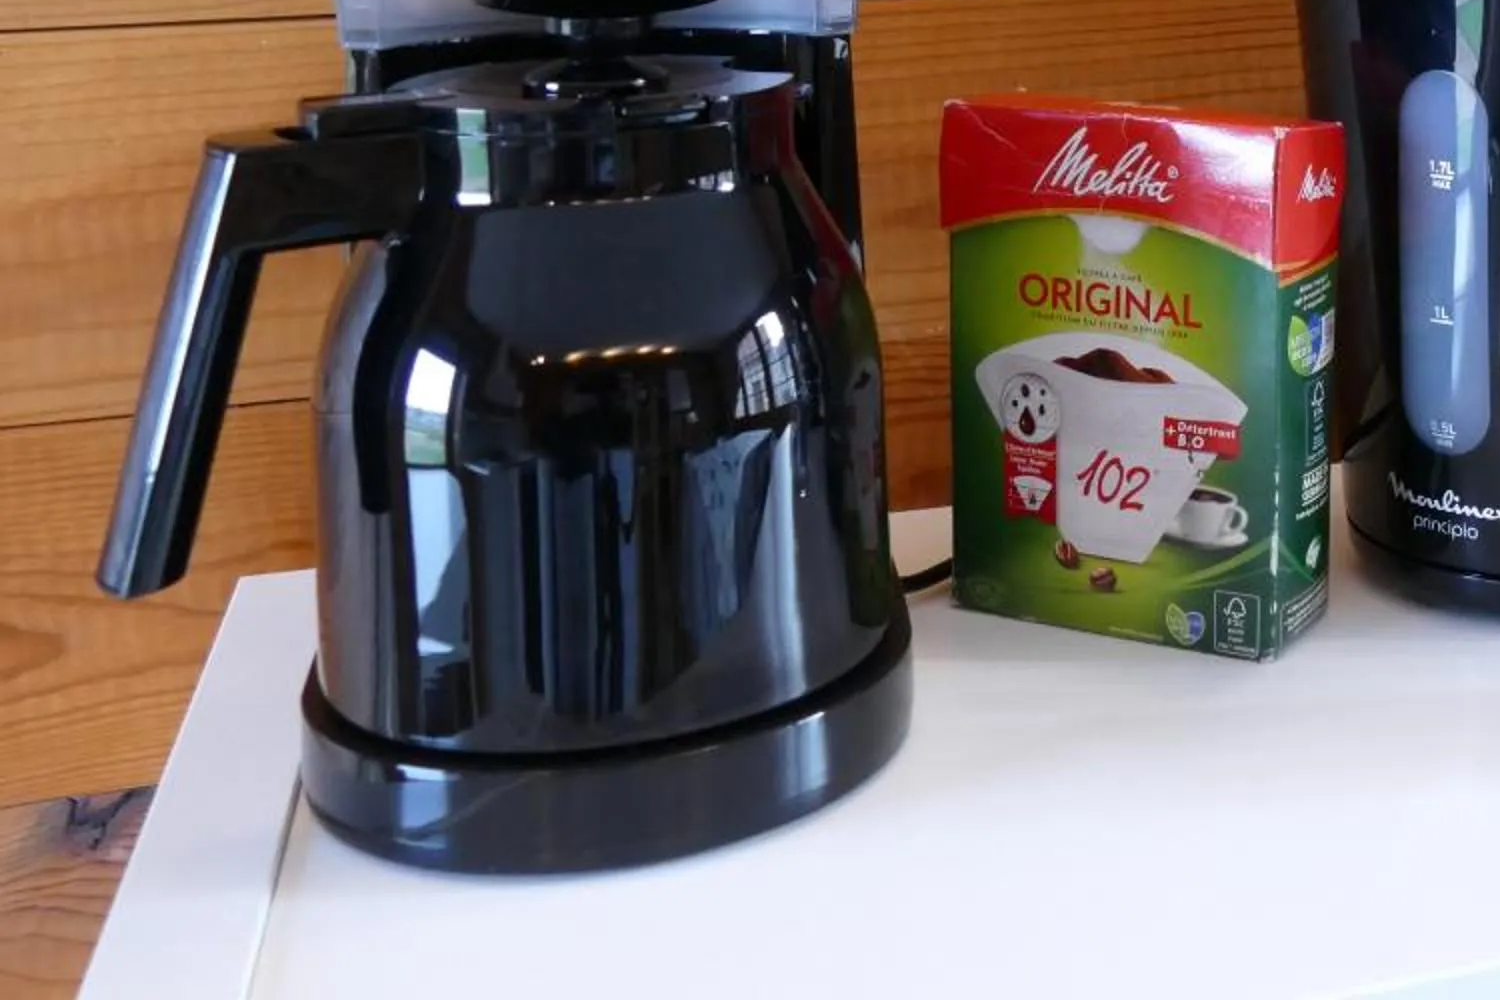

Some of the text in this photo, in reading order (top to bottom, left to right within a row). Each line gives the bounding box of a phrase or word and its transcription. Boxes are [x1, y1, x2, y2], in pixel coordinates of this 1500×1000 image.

[1033, 126, 1173, 202] Melitta
[1430, 160, 1455, 175] 1.7L
[1019, 272, 1203, 330] ORIGINAL
[1434, 305, 1449, 319] 1L
[1077, 449, 1151, 511] 102
[1413, 514, 1479, 541] principio
